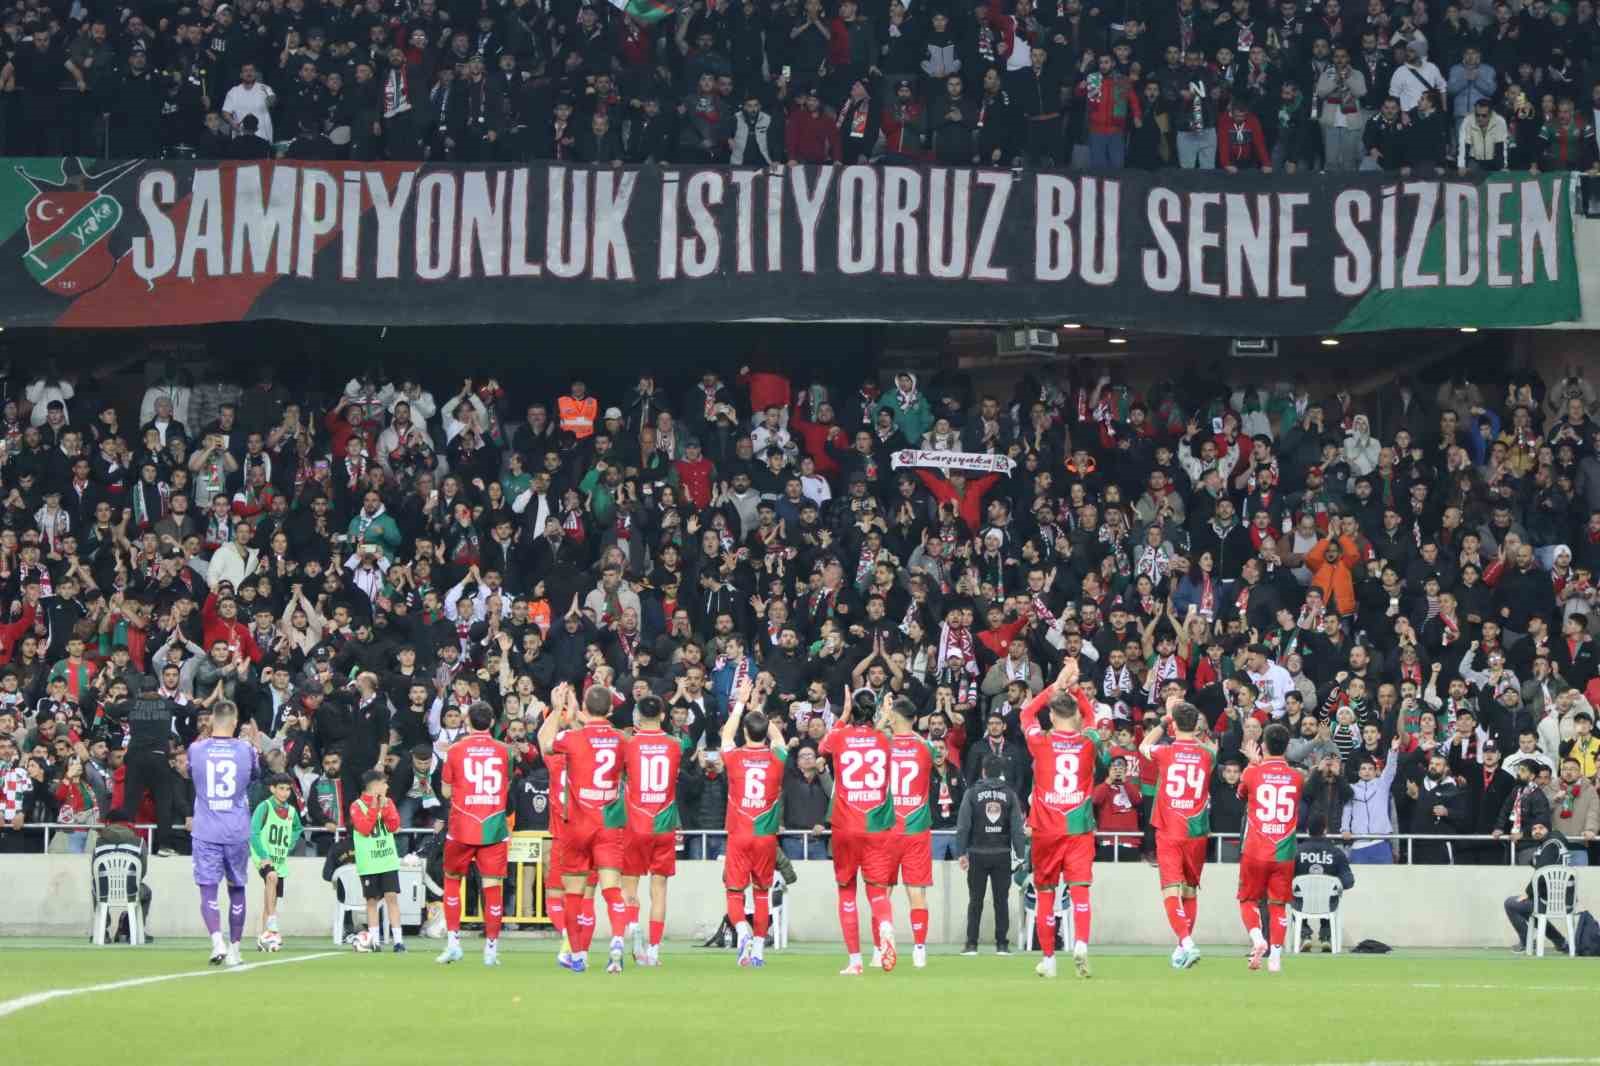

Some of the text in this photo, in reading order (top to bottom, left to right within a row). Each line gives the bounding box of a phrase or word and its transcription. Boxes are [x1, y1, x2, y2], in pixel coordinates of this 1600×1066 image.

[658, 164, 1012, 280] İSTİYORUZ
[1035, 173, 1119, 284] BU
[1143, 187, 1310, 297] SENE
[1334, 178, 1562, 296] SİZDEN
[206, 759, 237, 797] 13
[464, 757, 502, 794] 45
[593, 749, 616, 789] 2
[640, 755, 670, 791] 10
[744, 767, 766, 800] 6
[841, 749, 886, 790] 23
[890, 760, 919, 795] 17
[1054, 753, 1080, 792] 8
[1165, 763, 1205, 799] 54
[1255, 783, 1297, 822] 95
[1300, 850, 1334, 865] POLİS
